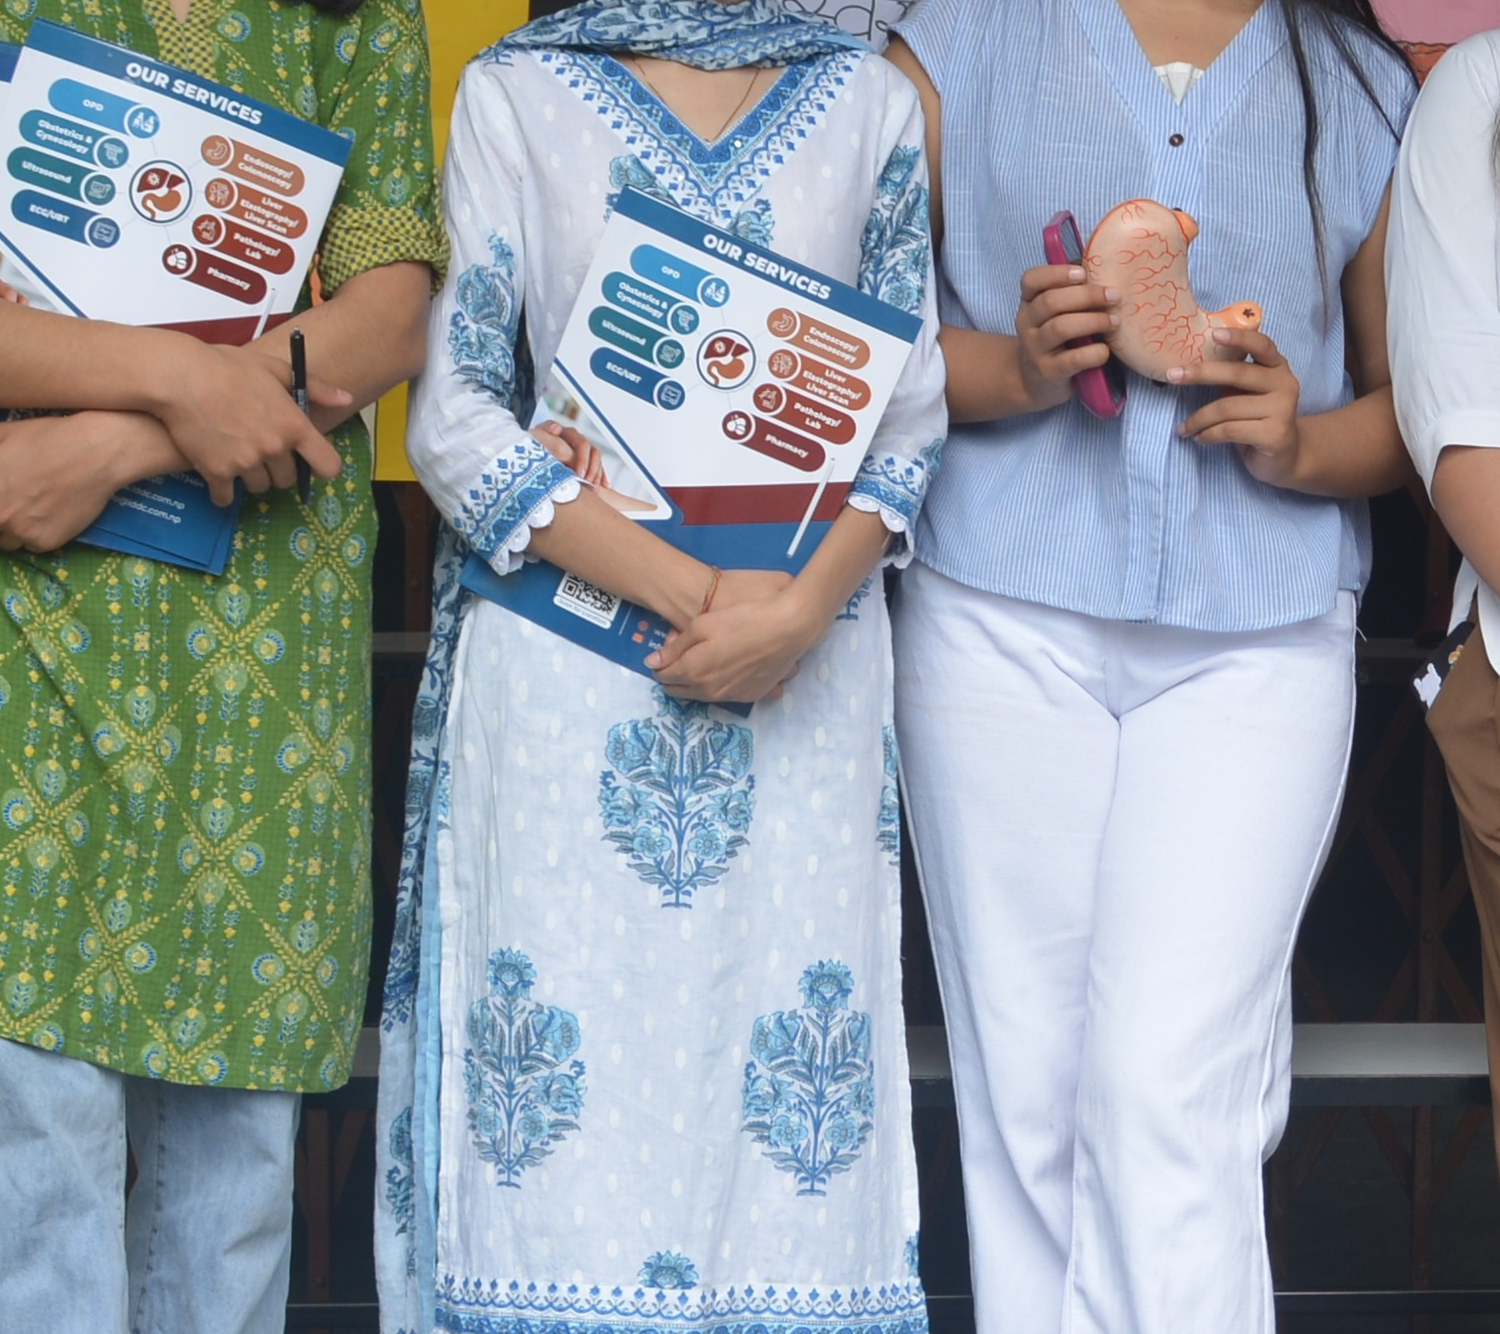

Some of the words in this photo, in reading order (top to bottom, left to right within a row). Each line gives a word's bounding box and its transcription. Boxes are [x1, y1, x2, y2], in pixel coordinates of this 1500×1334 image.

[125, 61, 171, 91] OUR
[172, 76, 263, 127] SERVICES
[82, 98, 104, 112] OPD
[244, 247, 263, 261] Lab
[702, 233, 744, 263] OUR
[743, 252, 833, 302] SERVICES
[804, 417, 822, 431] Lab
